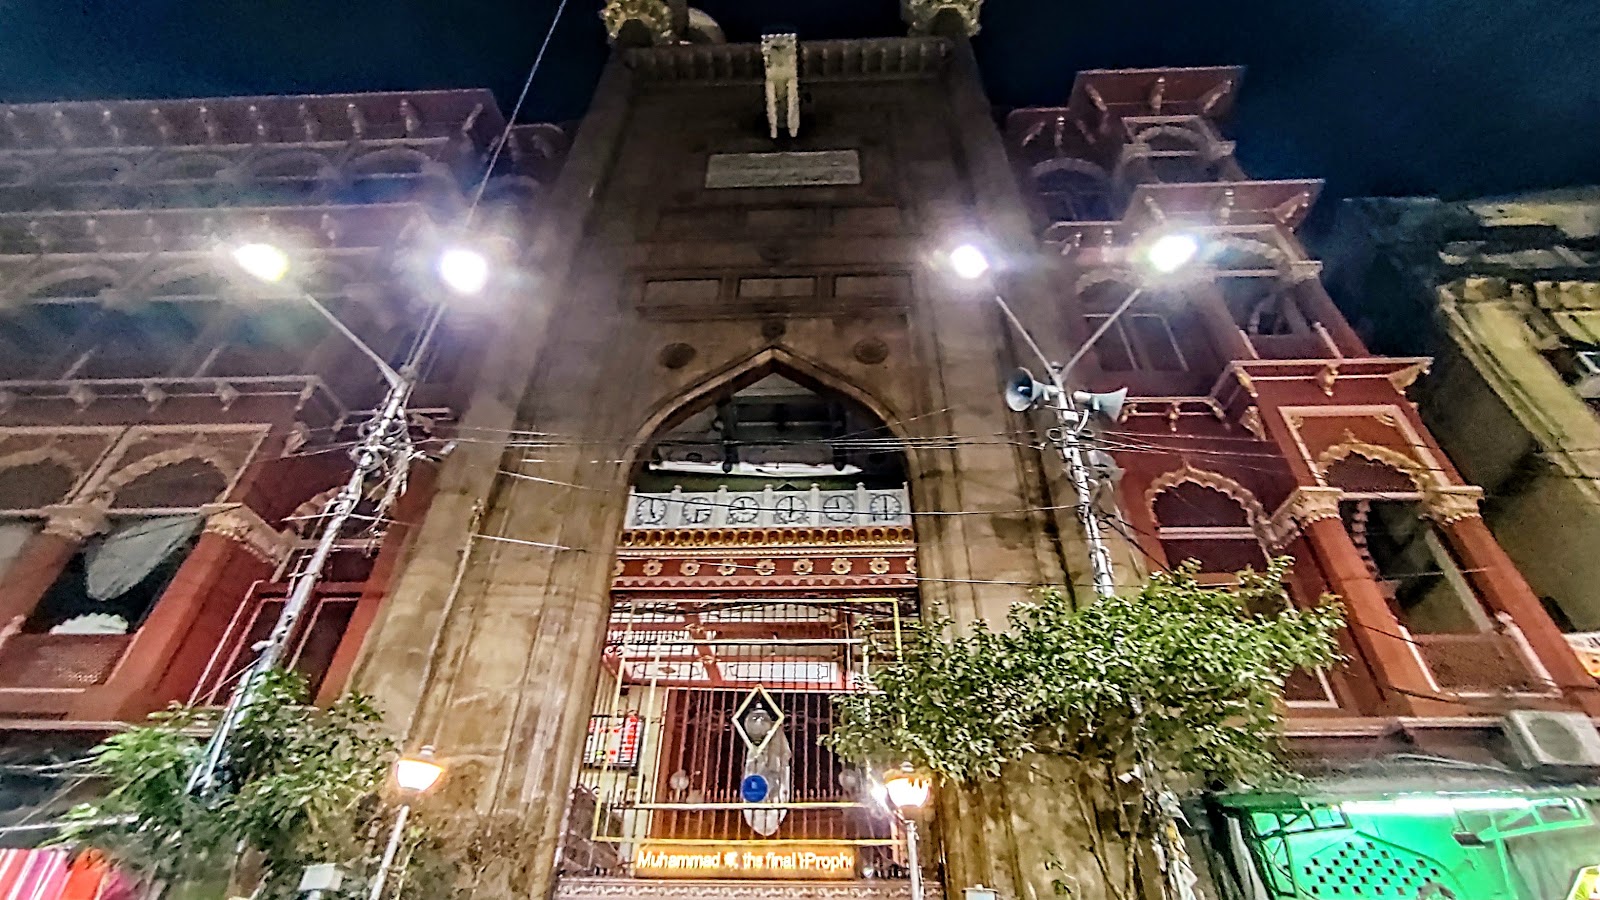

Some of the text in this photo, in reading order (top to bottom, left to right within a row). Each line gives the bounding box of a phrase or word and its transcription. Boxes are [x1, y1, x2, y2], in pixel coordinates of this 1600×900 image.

[636, 850, 721, 869] Muhammad
[741, 851, 763, 870] the
[765, 851, 797, 870] final
